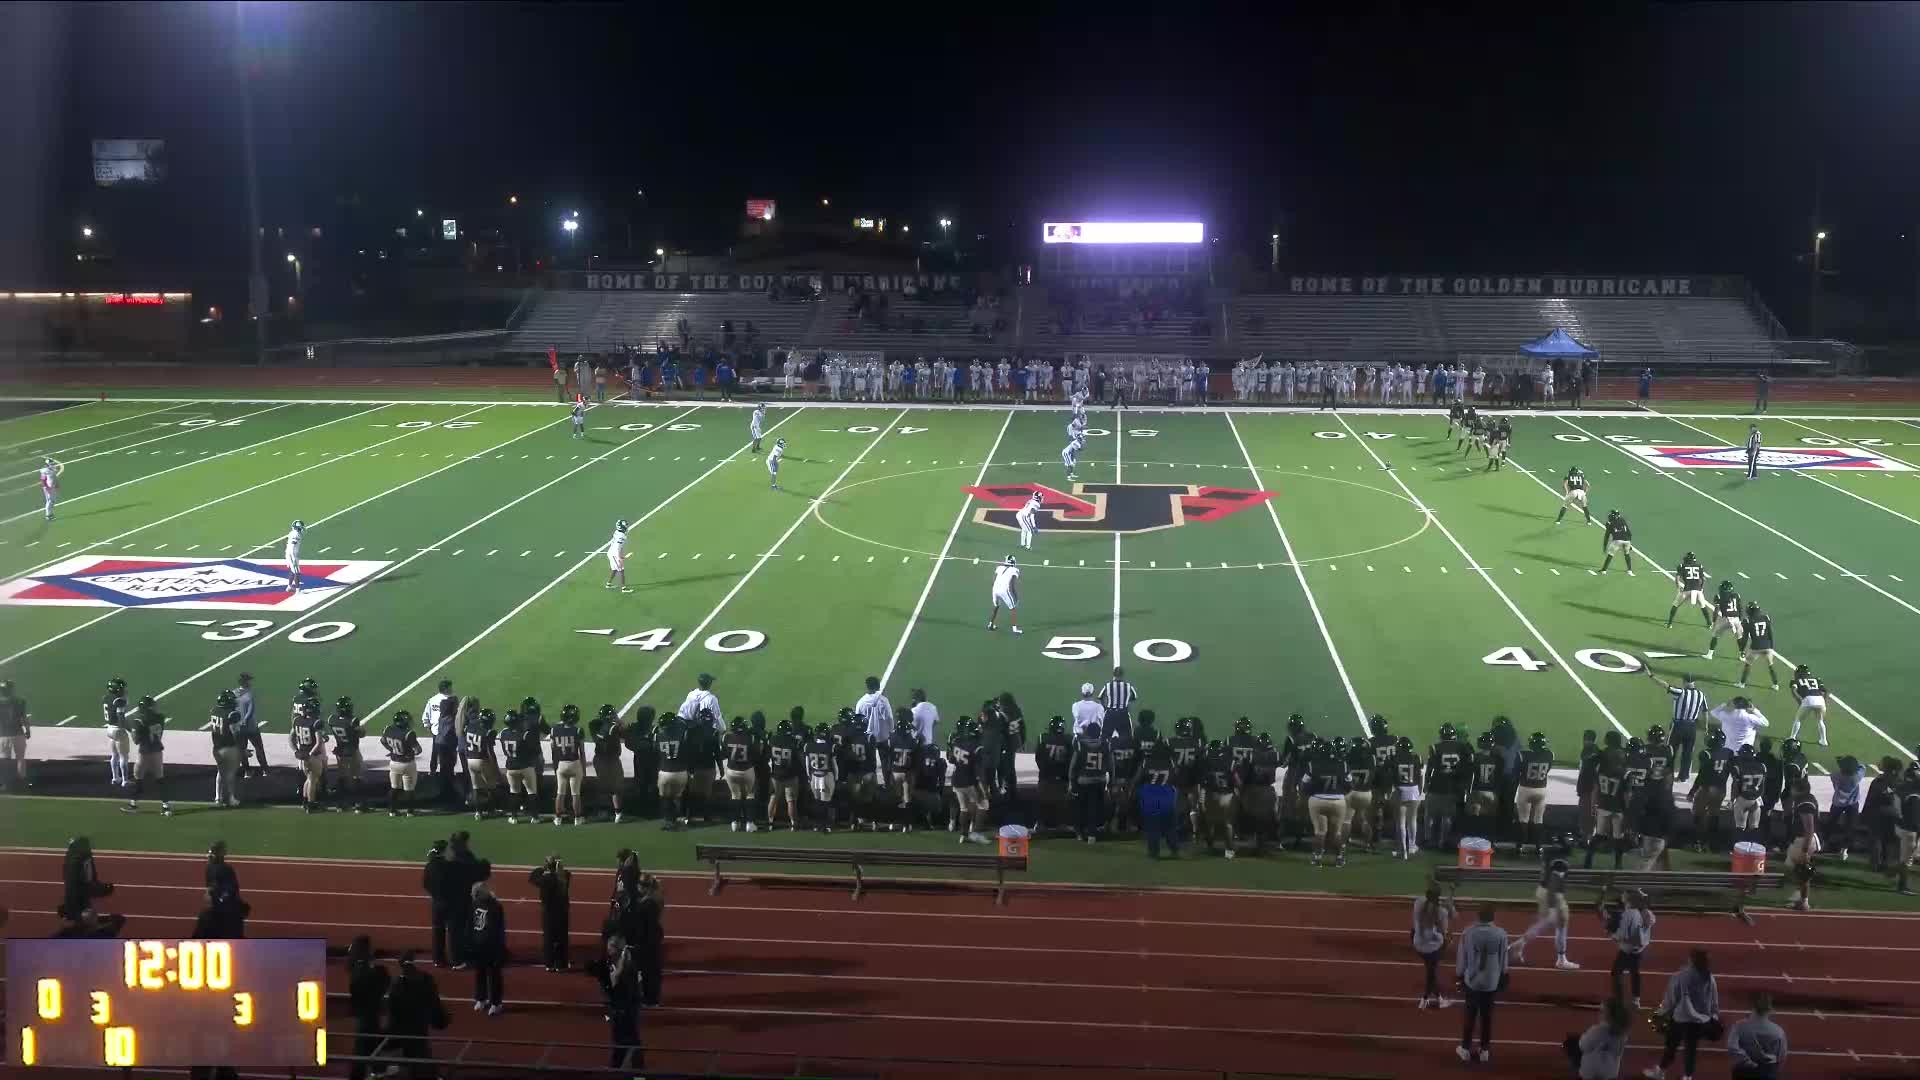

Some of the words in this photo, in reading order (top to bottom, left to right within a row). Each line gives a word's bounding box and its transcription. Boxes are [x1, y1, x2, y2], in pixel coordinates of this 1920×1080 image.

[587, 274, 645, 289] HOME
[655, 274, 679, 289] OF
[689, 275, 729, 289] THE
[1291, 277, 1352, 292] HOME
[1362, 278, 1386, 293] OF
[1402, 278, 1444, 293] THE
[1454, 278, 1542, 294] GOLDEN
[1553, 279, 1691, 294] HURRICANE
[1569, 475, 1583, 486] 44
[1684, 566, 1700, 580] 35
[90, 576, 279, 586] CENTENNIAL
[125, 584, 209, 593] BANK
[1754, 621, 1767, 637] 17
[1798, 678, 1821, 690] 43
[466, 732, 482, 753] 54
[555, 736, 575, 754] 44
[727, 743, 748, 762] 73
